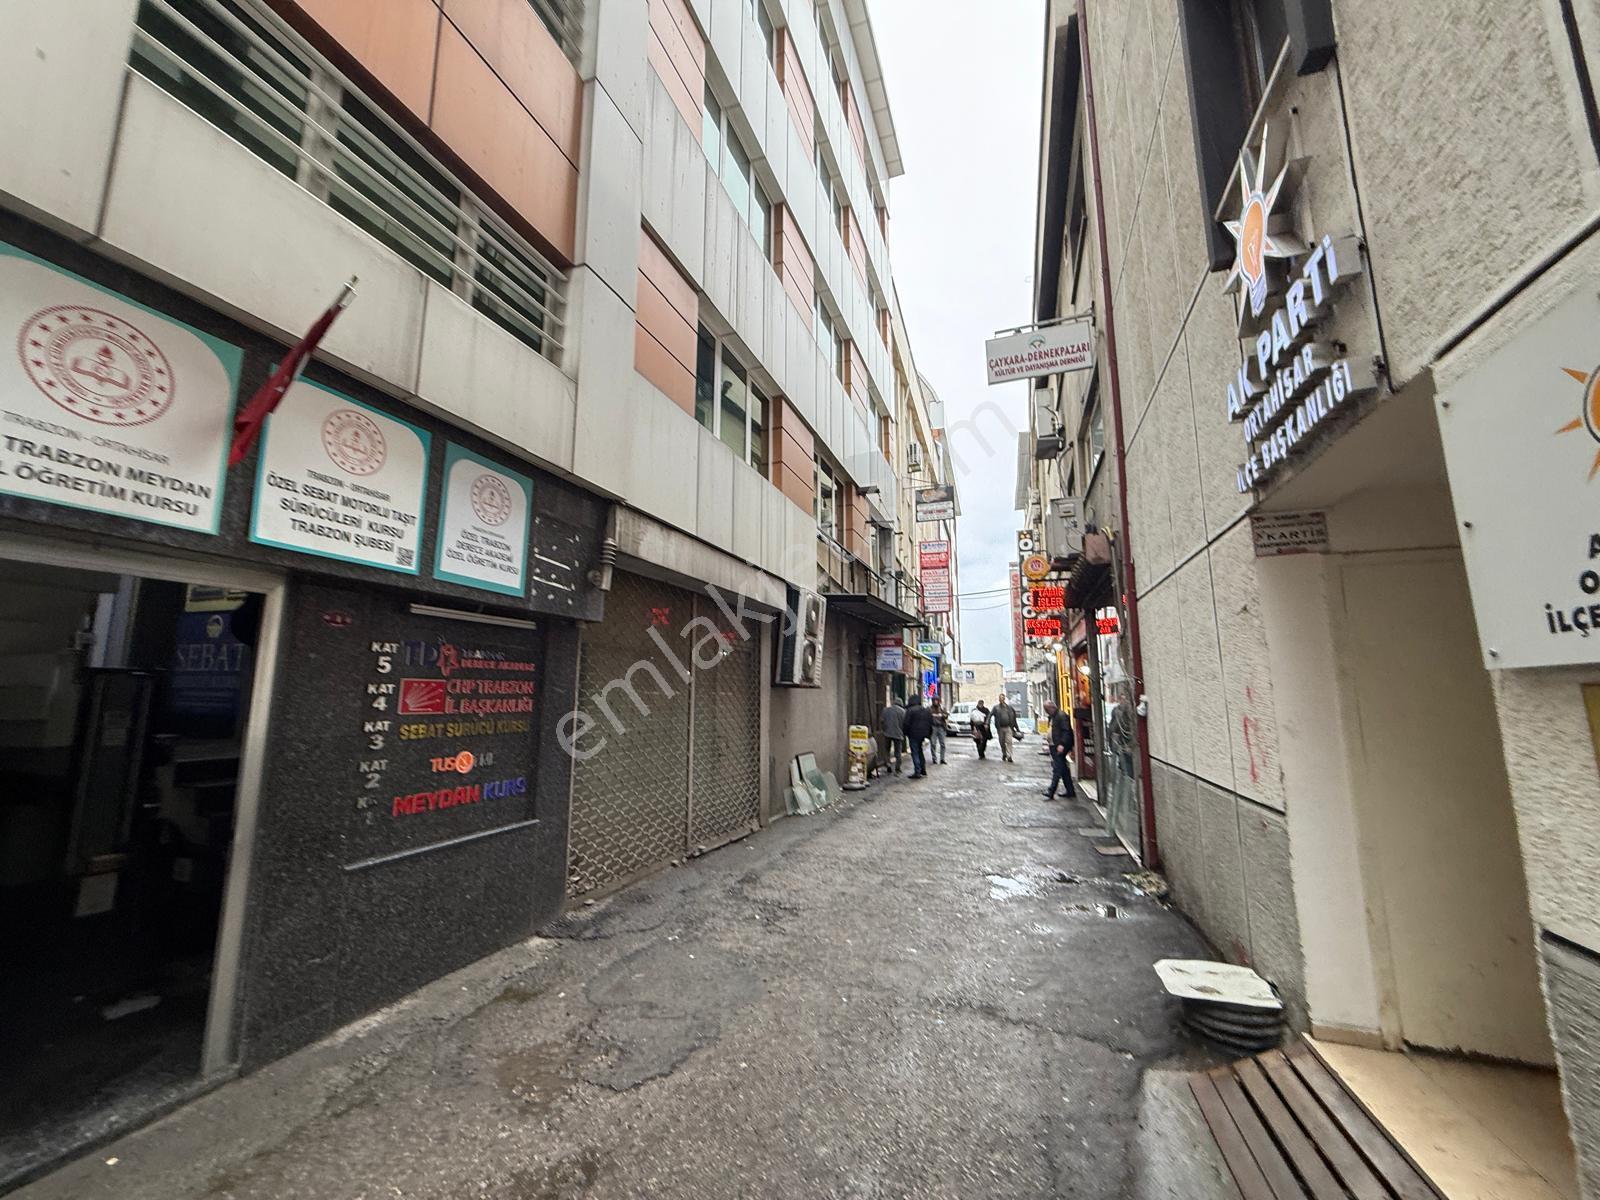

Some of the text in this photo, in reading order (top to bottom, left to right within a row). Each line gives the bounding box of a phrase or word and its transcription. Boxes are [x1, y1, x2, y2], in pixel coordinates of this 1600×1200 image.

[1226, 233, 1339, 424] AK PARTİ
[994, 368, 1016, 377] KÜLTÜR
[1025, 361, 1059, 372] DAYANIŞMA
[2, 434, 212, 499] TRABZON MEYDAN
[14, 461, 126, 501] ÖĞRETİM
[132, 491, 199, 516] KURSU
[266, 471, 300, 493] ÖZEL
[302, 484, 339, 503] SEBAT
[341, 496, 389, 518] MOTORLU
[280, 497, 404, 539] SÜRÜCÜLERİ KURSU
[290, 518, 394, 552] TRABZON ŞUBESİ
[372, 641, 399, 654] KAT
[376, 656, 392, 674] 5
[367, 684, 396, 695] KAT
[372, 696, 388, 712] 4
[363, 720, 393, 733] KAT
[400, 724, 444, 740] SEBAT
[368, 734, 385, 750] 3
[359, 759, 389, 773] KAT
[364, 773, 381, 789] 2
[391, 784, 481, 817] MEYDAN
[483, 776, 527, 800] KURS
